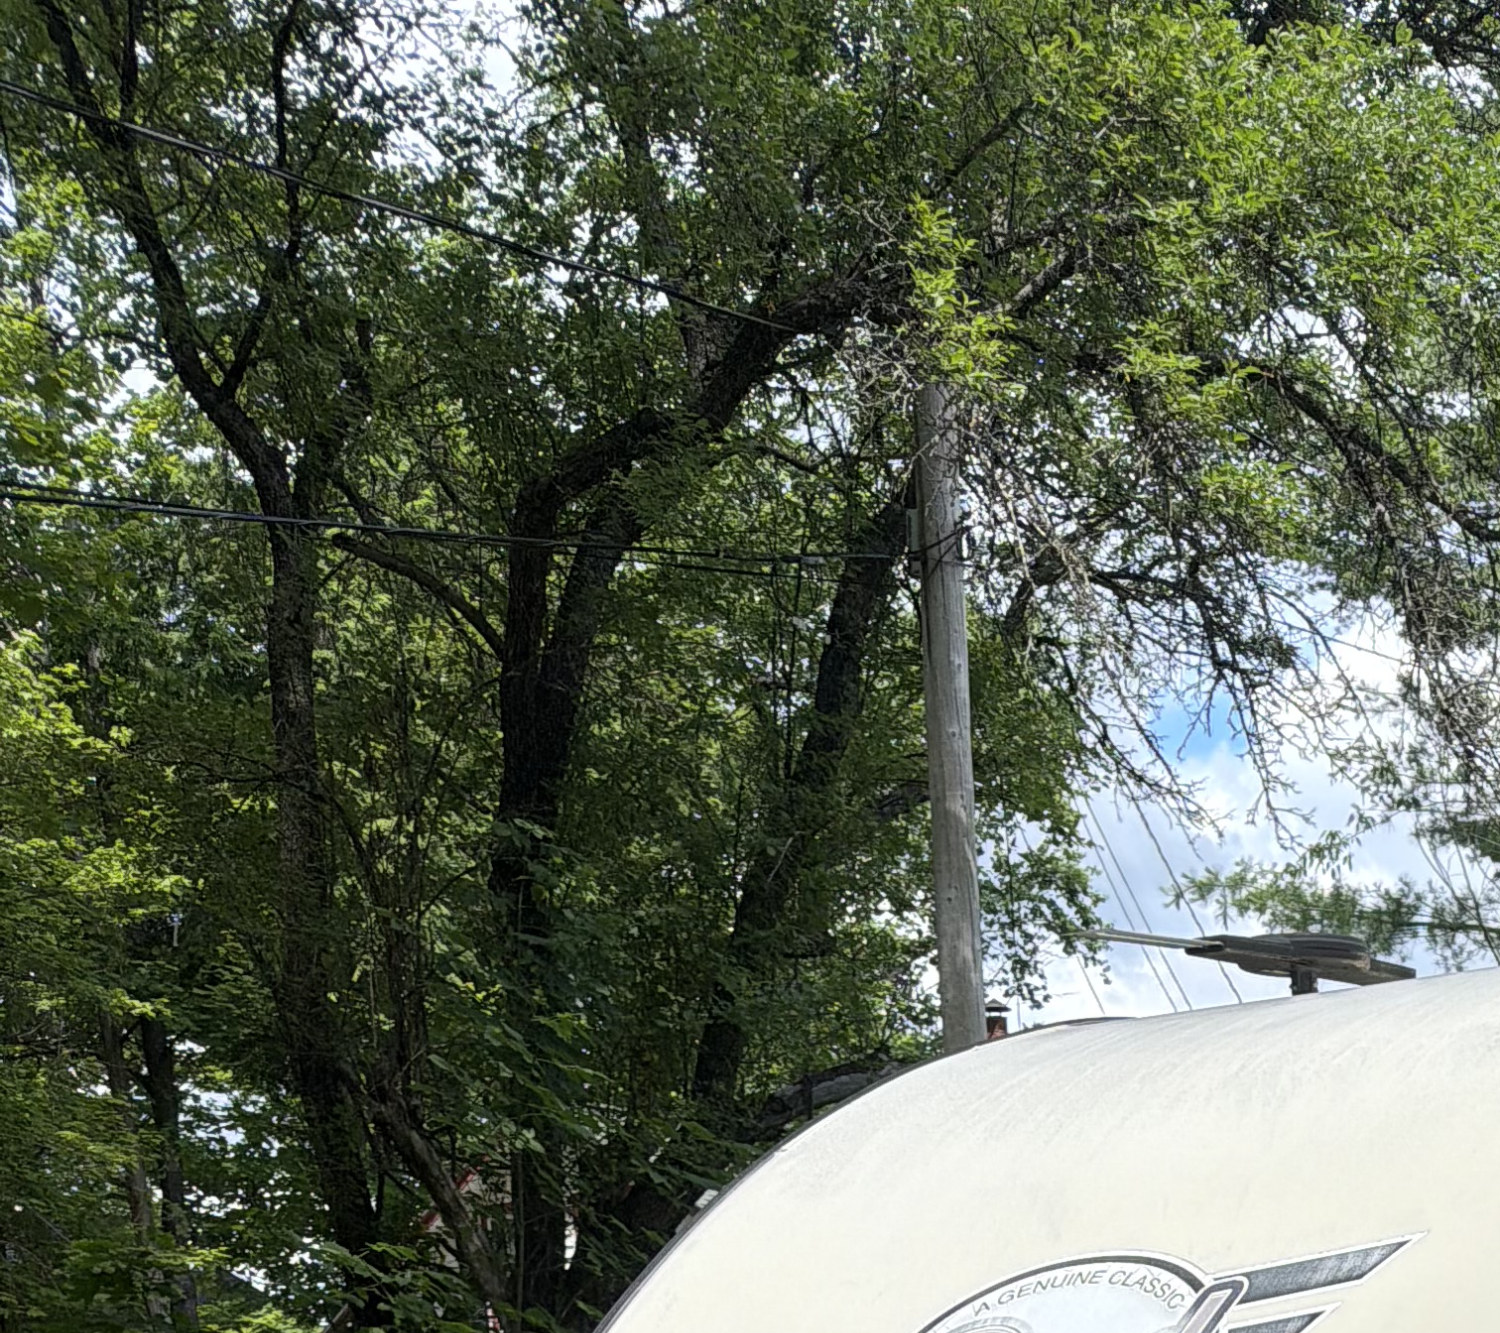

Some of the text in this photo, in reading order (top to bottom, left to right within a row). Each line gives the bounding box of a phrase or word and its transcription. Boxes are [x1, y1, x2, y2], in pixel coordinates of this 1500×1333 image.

[973, 1270, 1186, 1317] A GENUINE CLASSIC
